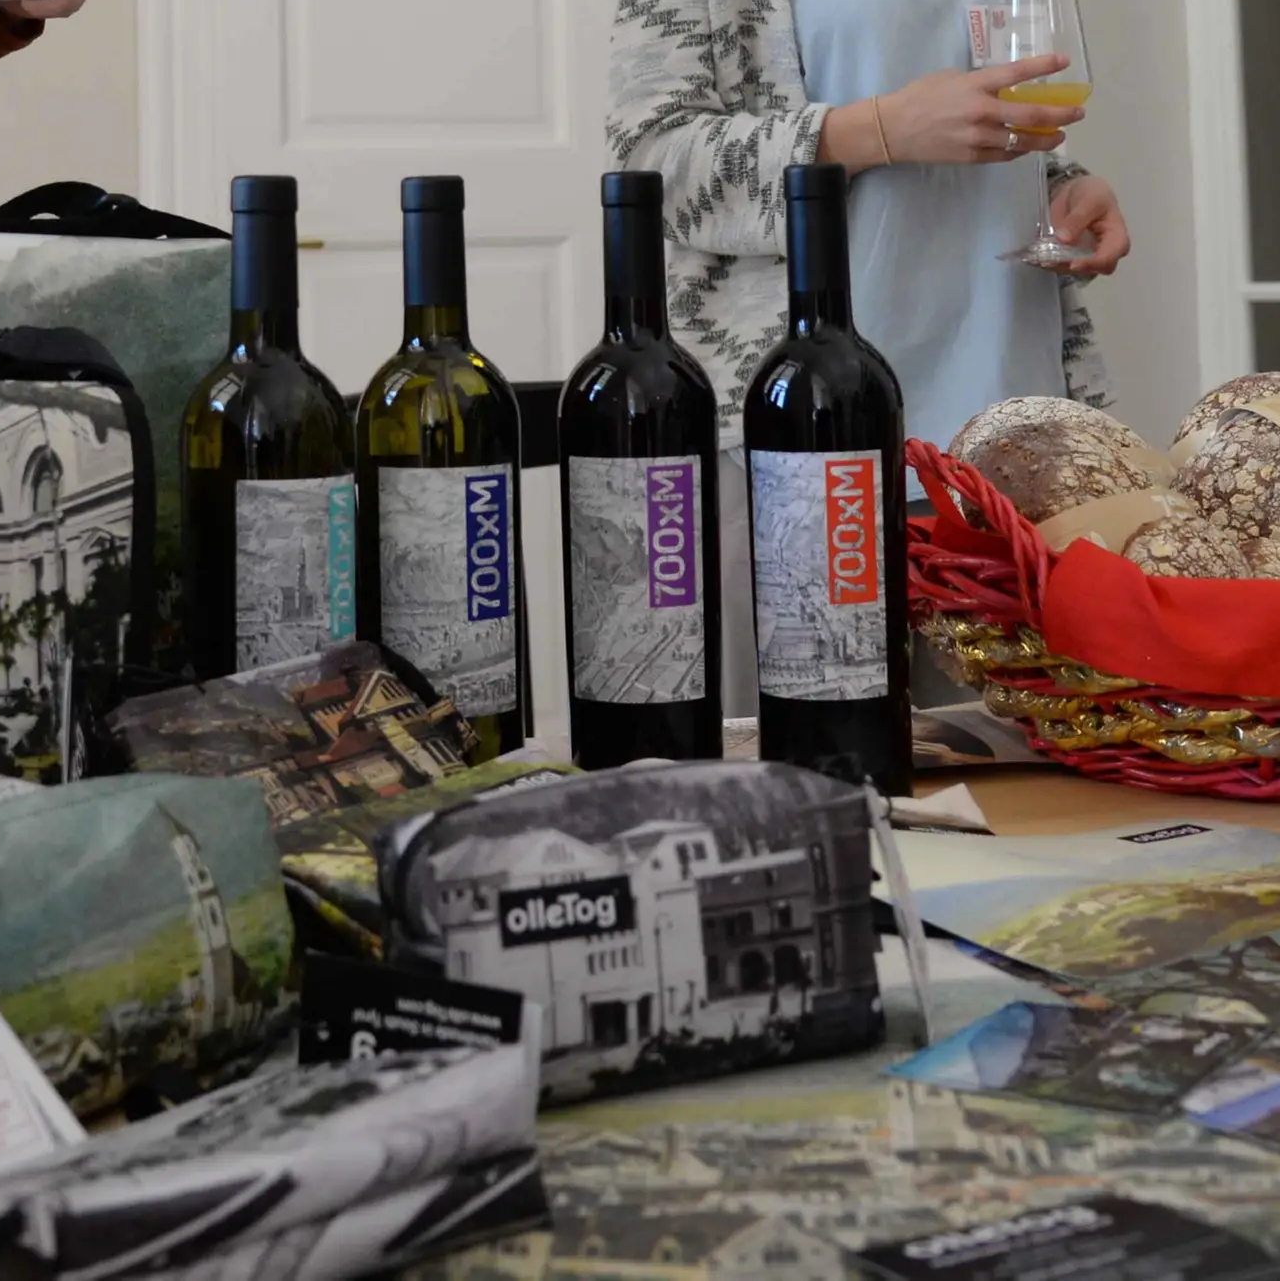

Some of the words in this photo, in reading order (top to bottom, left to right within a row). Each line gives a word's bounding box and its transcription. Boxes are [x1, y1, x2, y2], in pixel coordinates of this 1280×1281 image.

[469, 479, 501, 617] 700xM
[651, 469, 686, 605] 700xM
[830, 465, 867, 600] 700xM
[506, 892, 618, 935] olleTog
